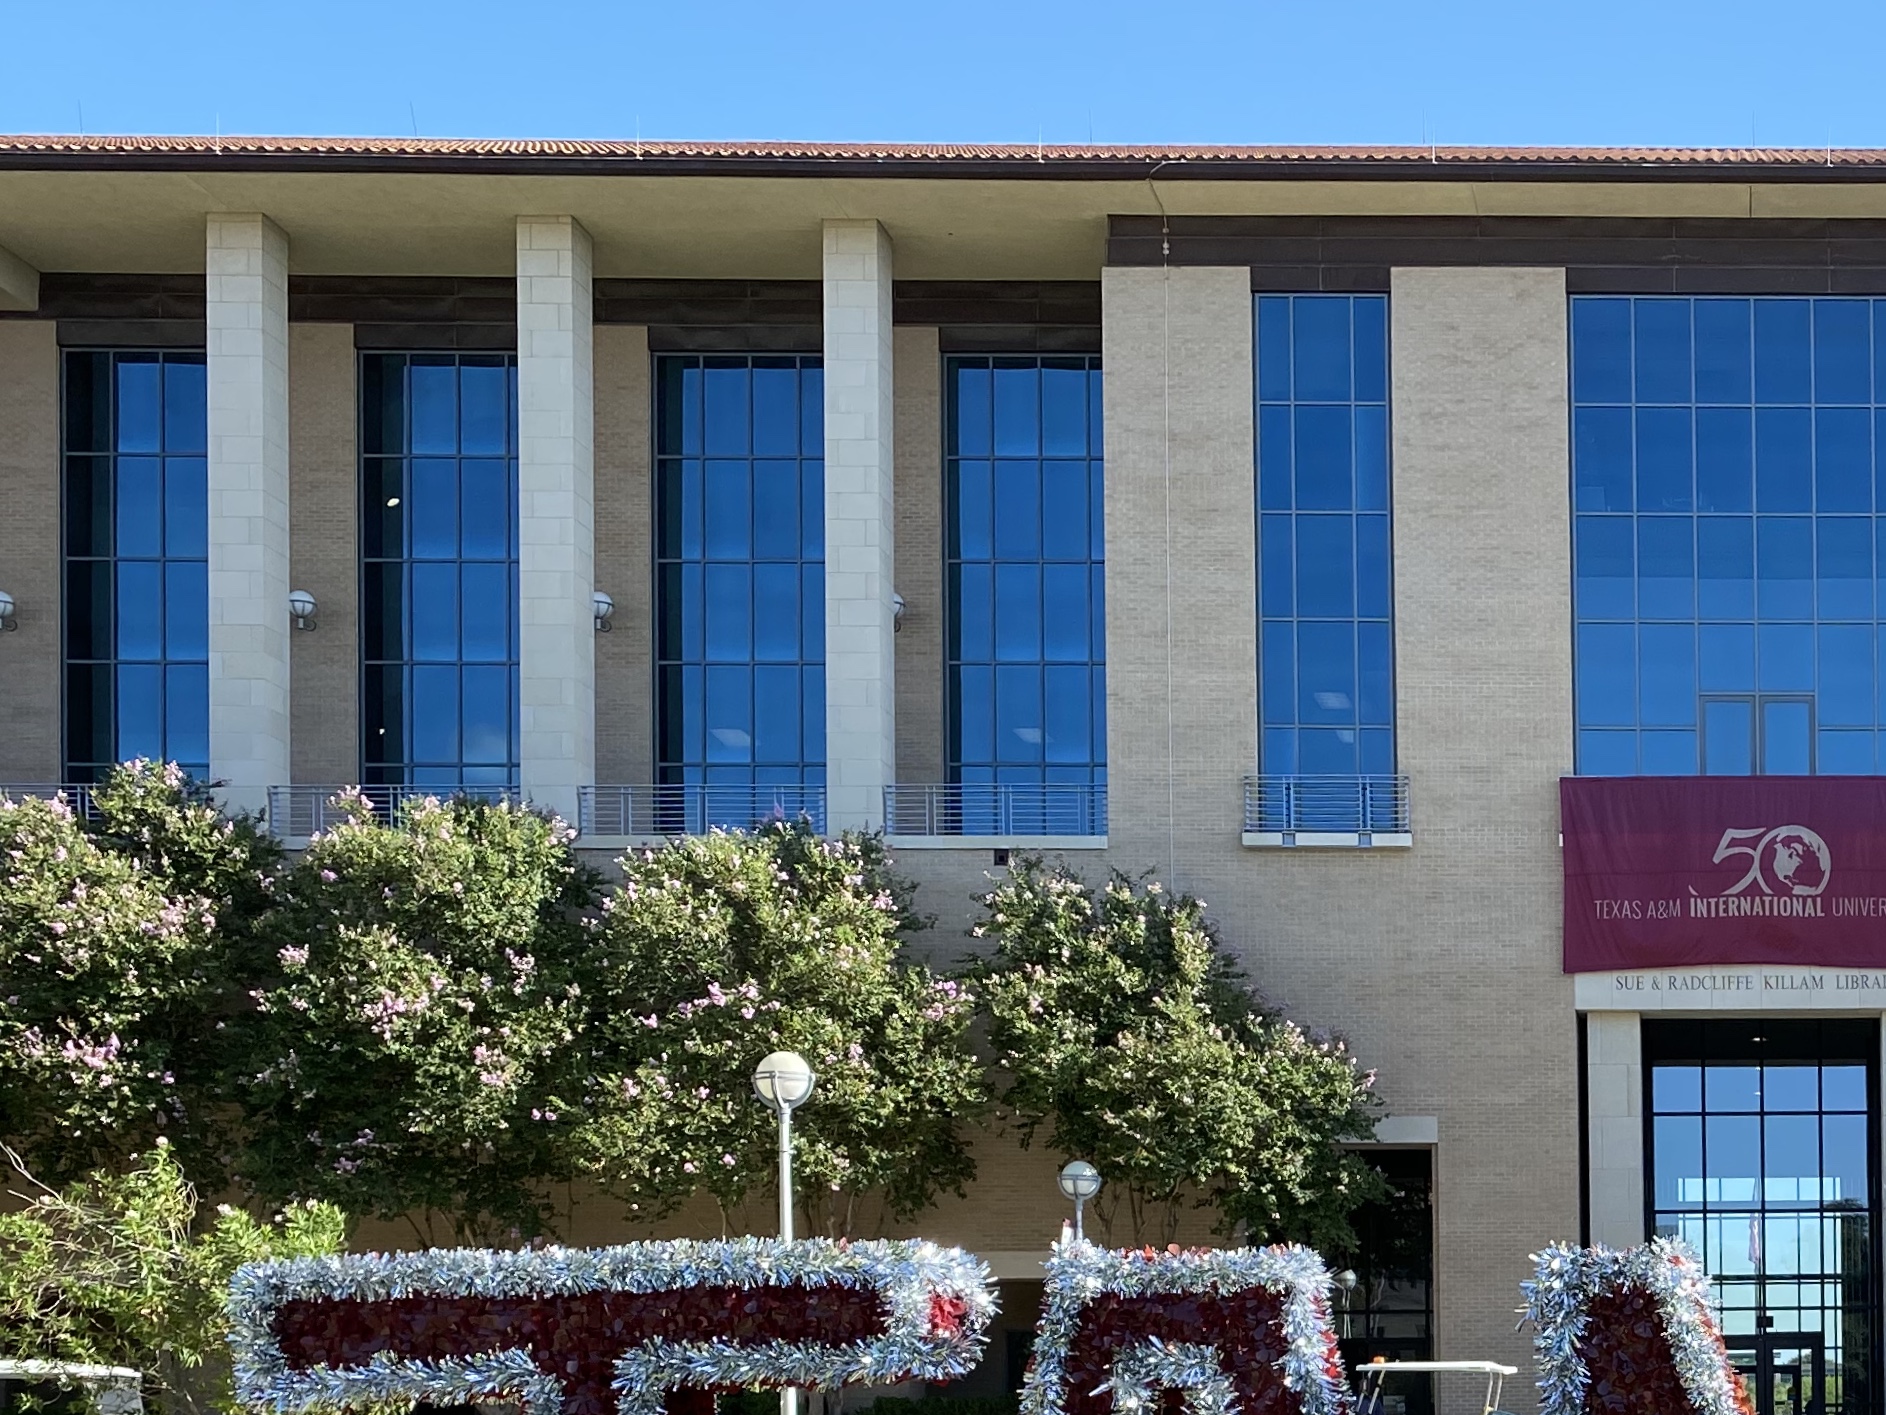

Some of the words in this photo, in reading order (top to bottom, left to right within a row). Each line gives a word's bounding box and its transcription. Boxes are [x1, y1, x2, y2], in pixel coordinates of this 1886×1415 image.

[1689, 825, 1831, 896] 50
[1594, 900, 1642, 920] TEXAS
[1646, 899, 1681, 919] A&M
[1690, 896, 1825, 918] INTERNATIONAL
[1615, 975, 1645, 991] SUE
[1651, 975, 1661, 991] &
[1668, 975, 1754, 991] RADCLIFFE
[1763, 974, 1824, 990] KILLAM
